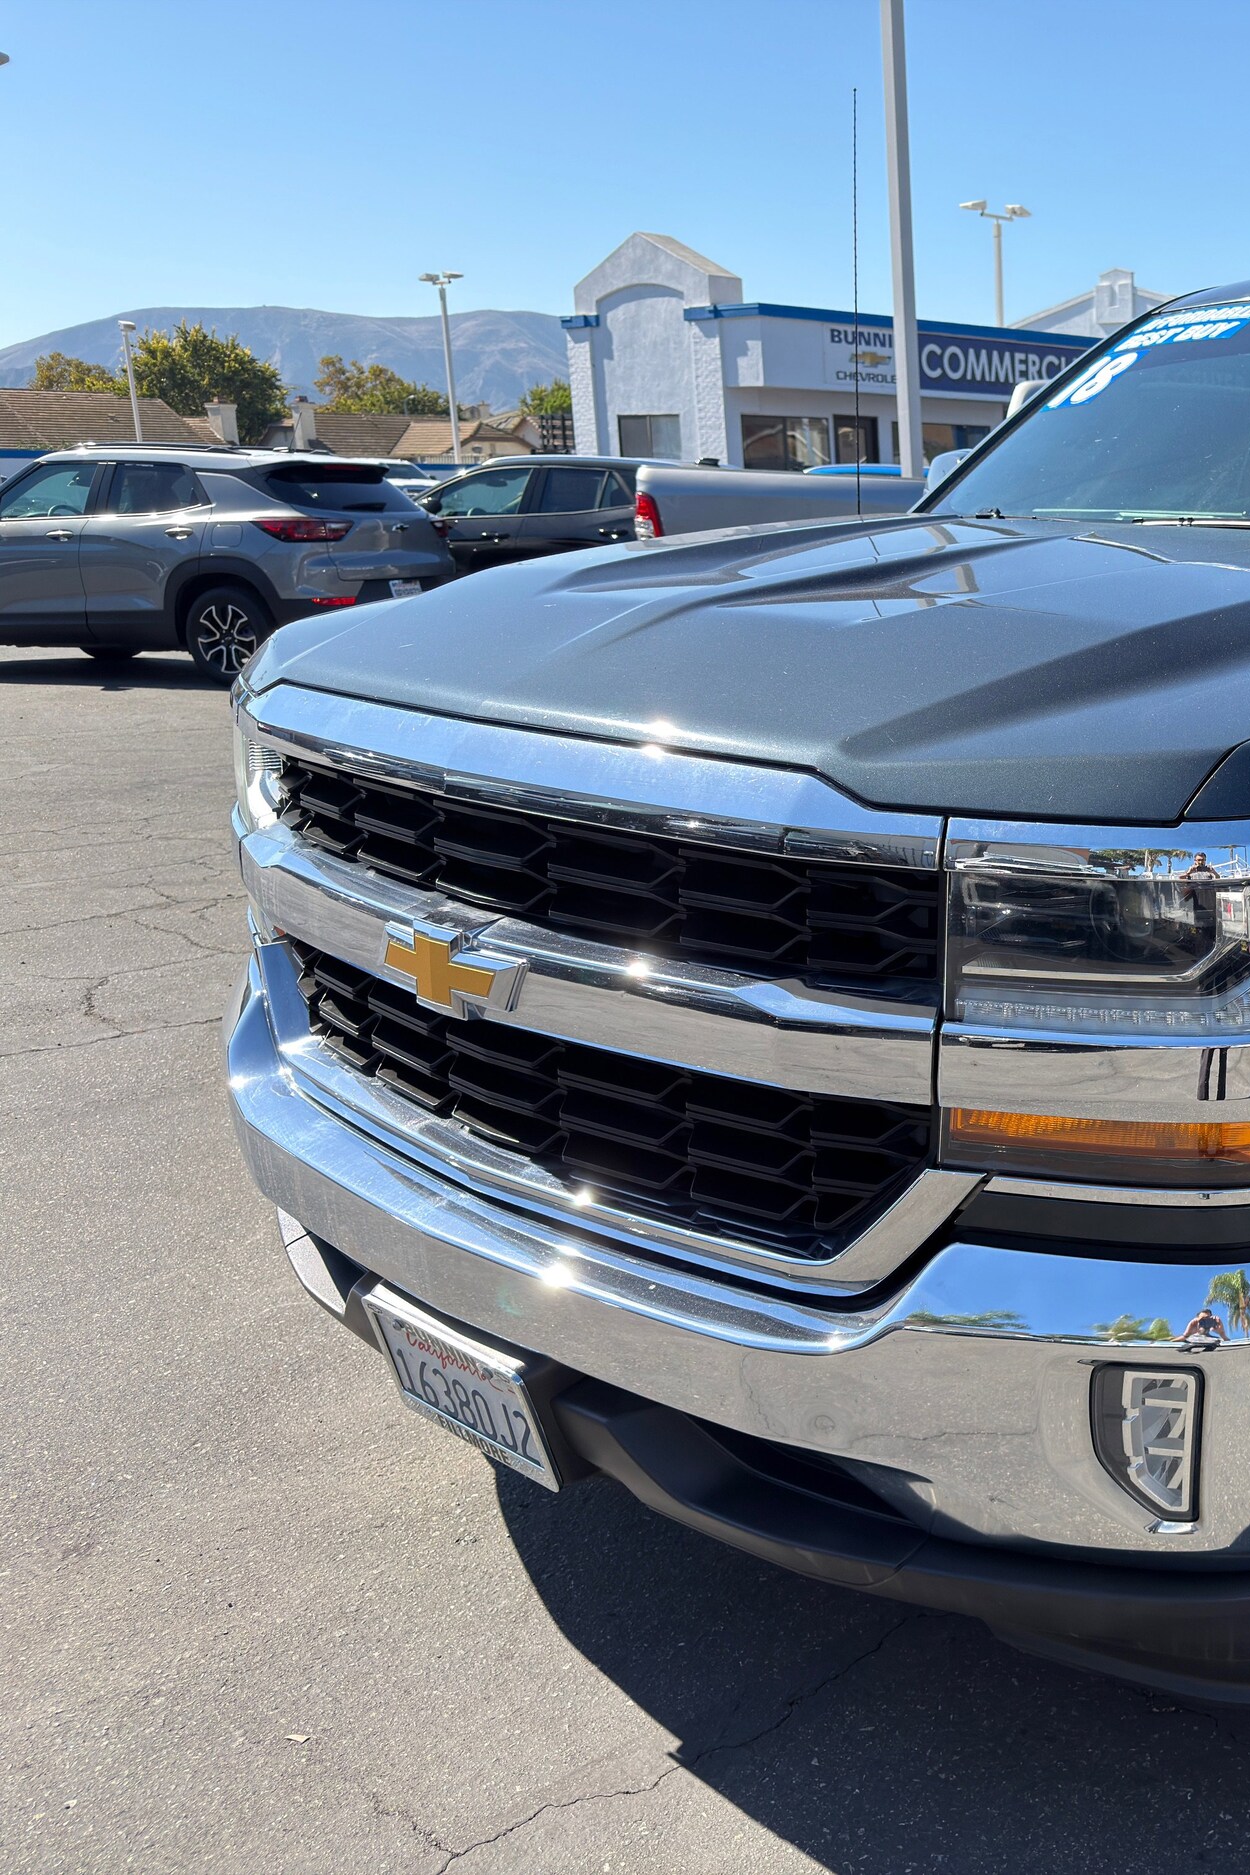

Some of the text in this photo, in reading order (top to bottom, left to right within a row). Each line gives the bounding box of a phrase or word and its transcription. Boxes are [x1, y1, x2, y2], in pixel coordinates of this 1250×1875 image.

[830, 328, 893, 348] BUNNI
[1172, 321, 1241, 342] BUY
[835, 370, 897, 384] CHEVROLE
[920, 343, 1077, 384] COMMERCI
[1048, 352, 1138, 409] 18
[396, 1348, 543, 1467] 16380J2
[437, 1414, 513, 1465] FILLMORE
